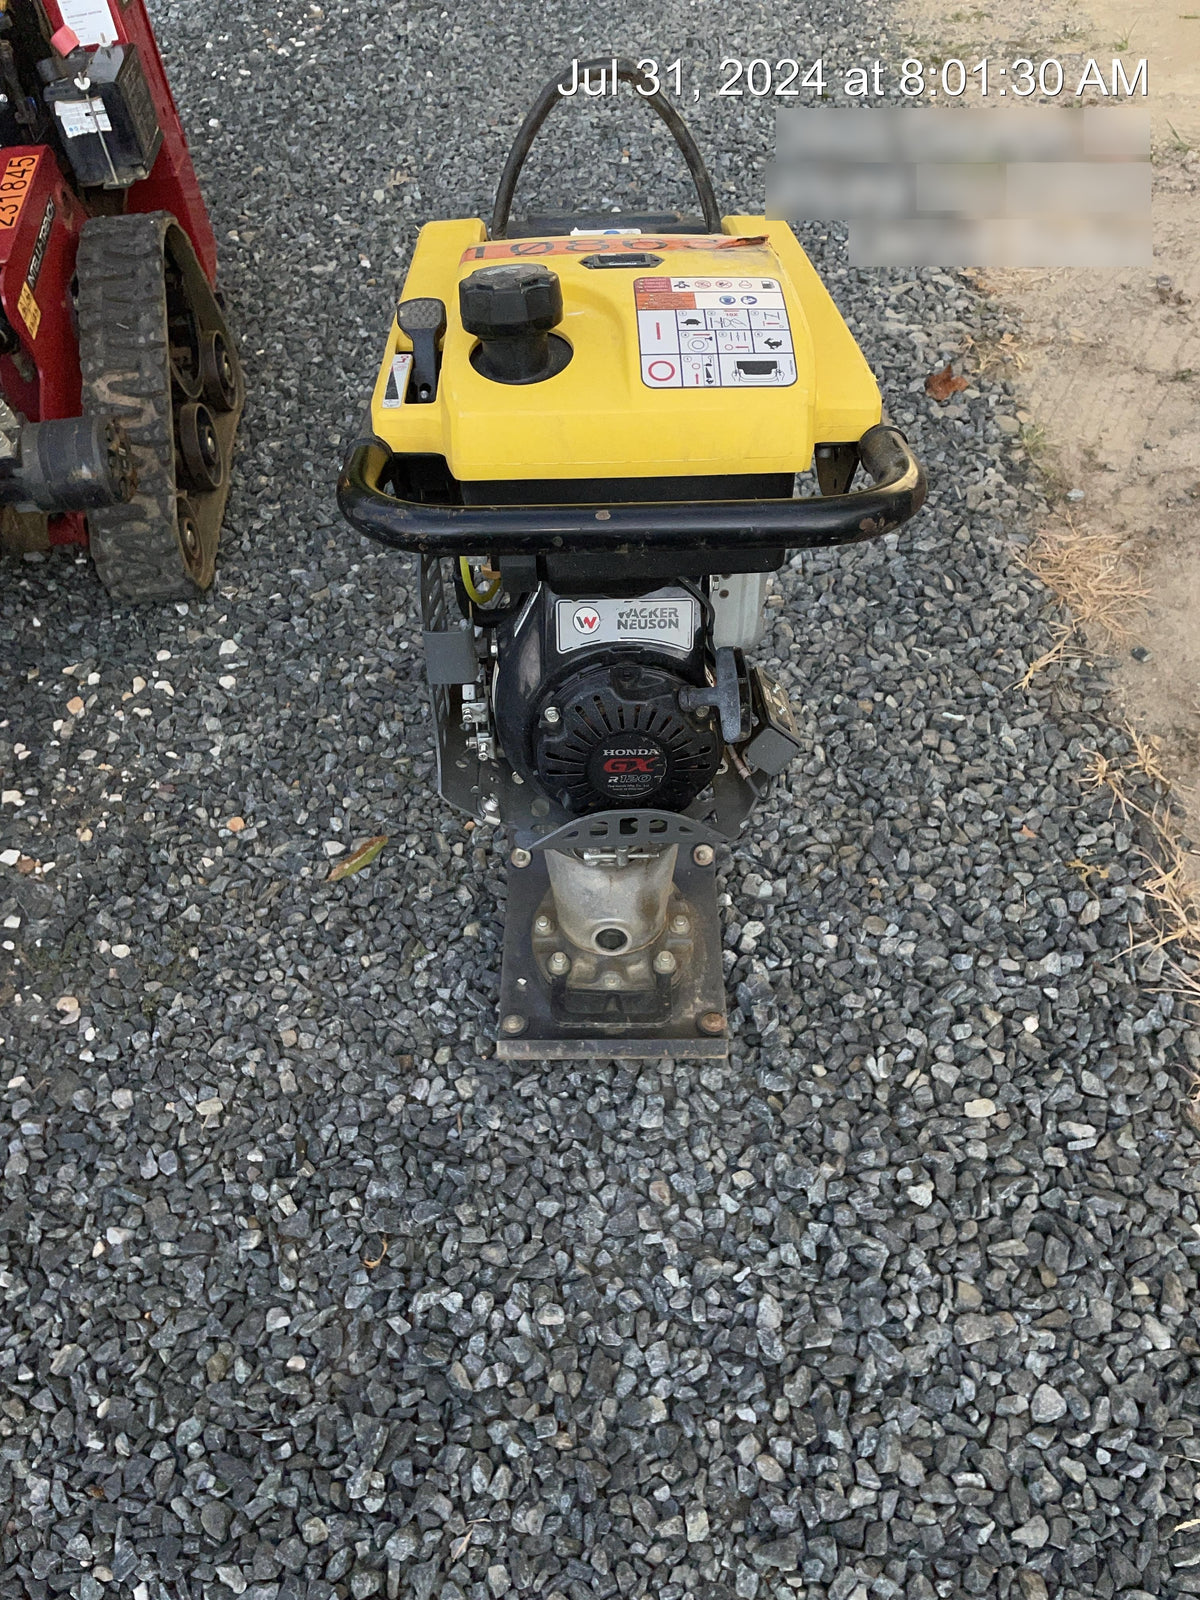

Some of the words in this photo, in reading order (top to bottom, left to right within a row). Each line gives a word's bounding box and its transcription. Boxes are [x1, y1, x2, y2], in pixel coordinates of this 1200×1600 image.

[618, 607, 679, 619] WACKER
[617, 618, 680, 630] NEUSON
[603, 748, 660, 756] HONDA
[603, 756, 657, 773] GX
